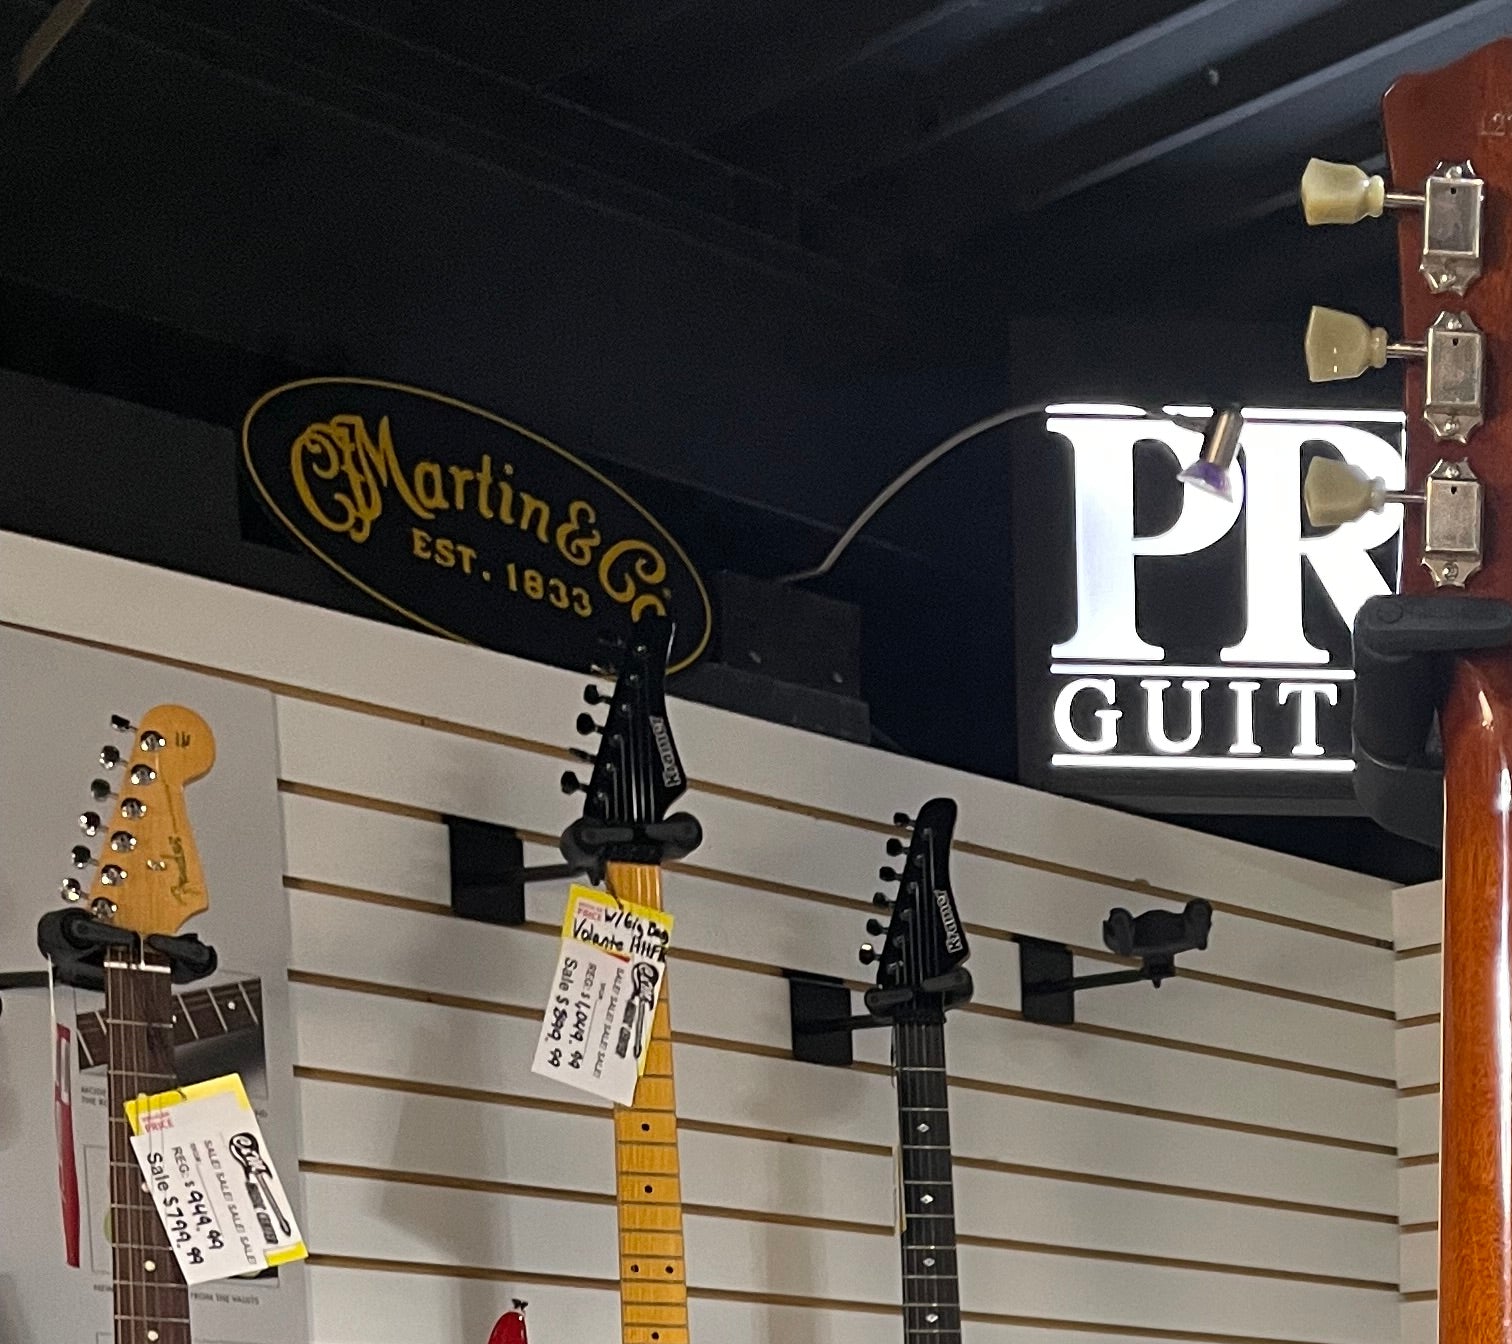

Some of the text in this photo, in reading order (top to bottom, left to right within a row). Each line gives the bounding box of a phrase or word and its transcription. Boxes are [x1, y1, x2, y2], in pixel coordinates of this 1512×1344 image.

[411, 528, 594, 617] EST. 1833
[1046, 417, 1404, 663] PR
[648, 715, 681, 787] Kramer
[1054, 678, 1338, 756] GUIT
[933, 889, 963, 953] Kramer
[559, 957, 578, 992] Sale
[147, 1152, 169, 1191] Sale
